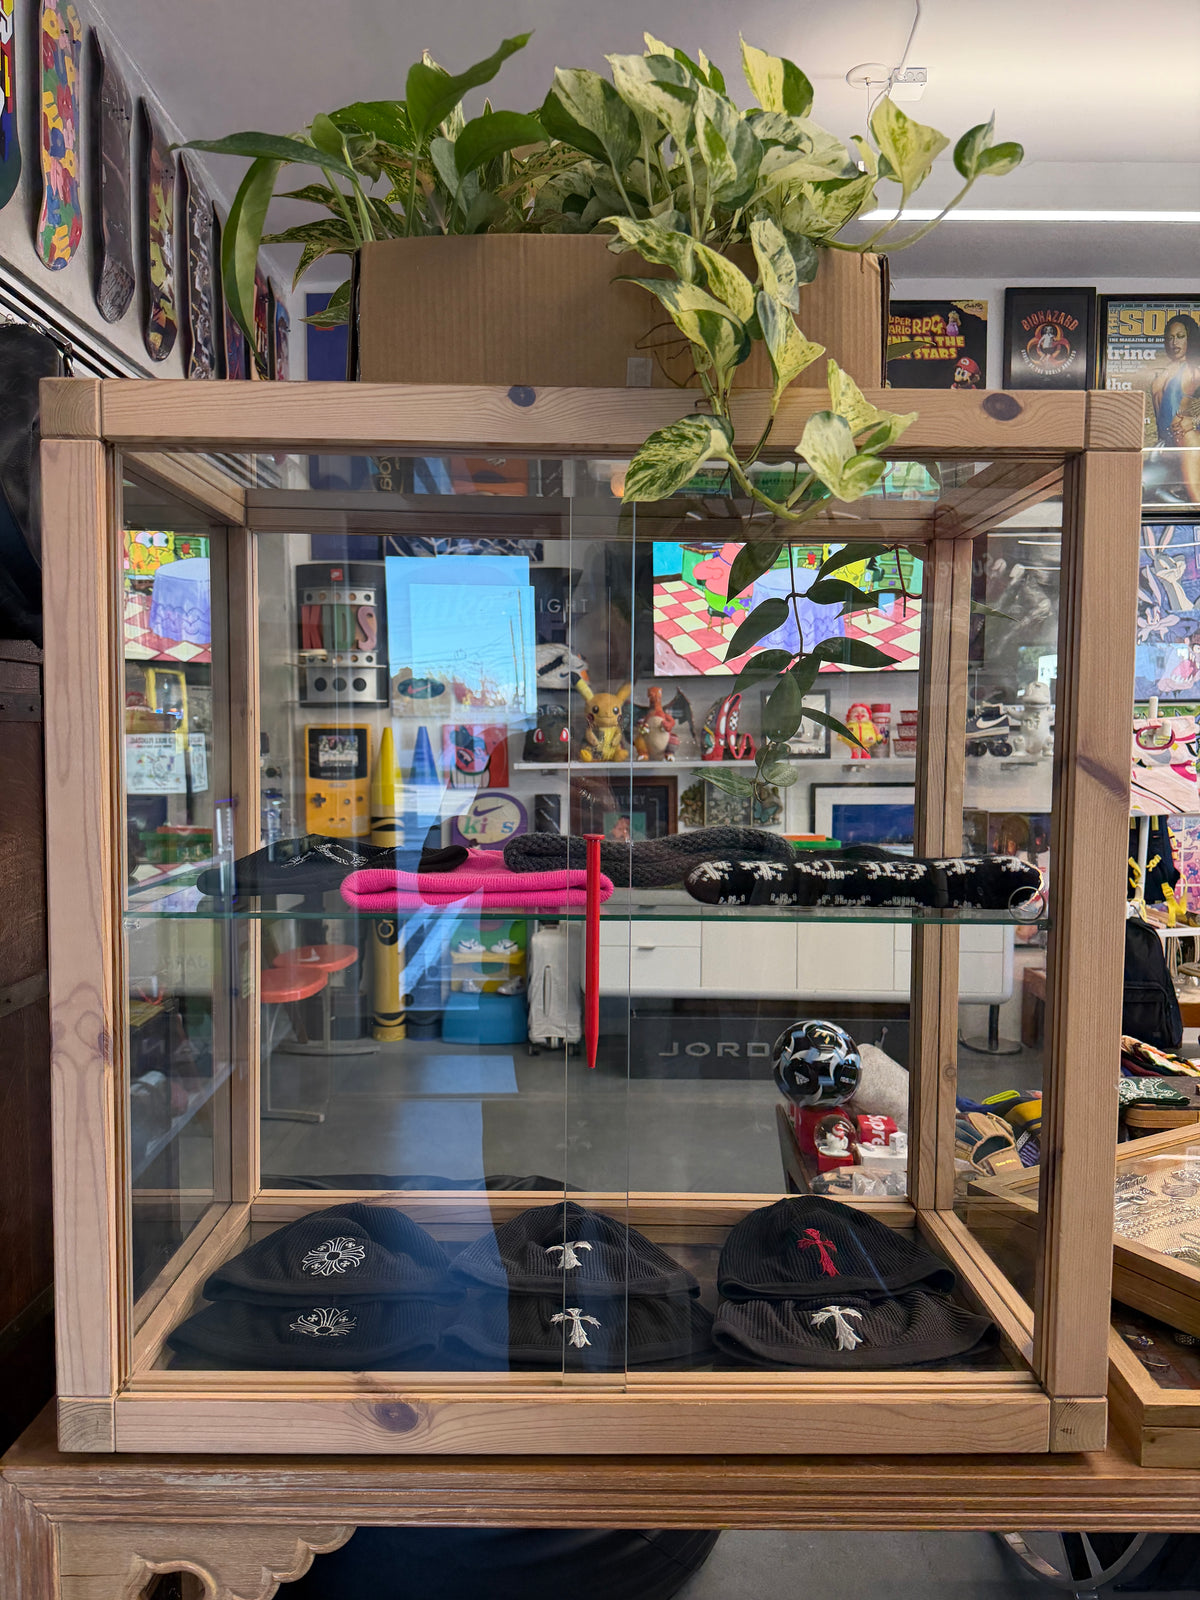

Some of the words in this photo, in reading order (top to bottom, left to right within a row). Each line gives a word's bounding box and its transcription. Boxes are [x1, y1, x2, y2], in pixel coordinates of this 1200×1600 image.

[888, 316, 911, 326] UPER
[911, 315, 946, 335] RPG
[1021, 309, 1079, 331] BIOHAZARD
[888, 325, 911, 335] ARIO
[935, 335, 965, 347] THE
[913, 347, 957, 359] STARS
[301, 603, 378, 651] KIDS
[658, 1041, 770, 1057] JORD
[863, 1114, 887, 1146] Supre
